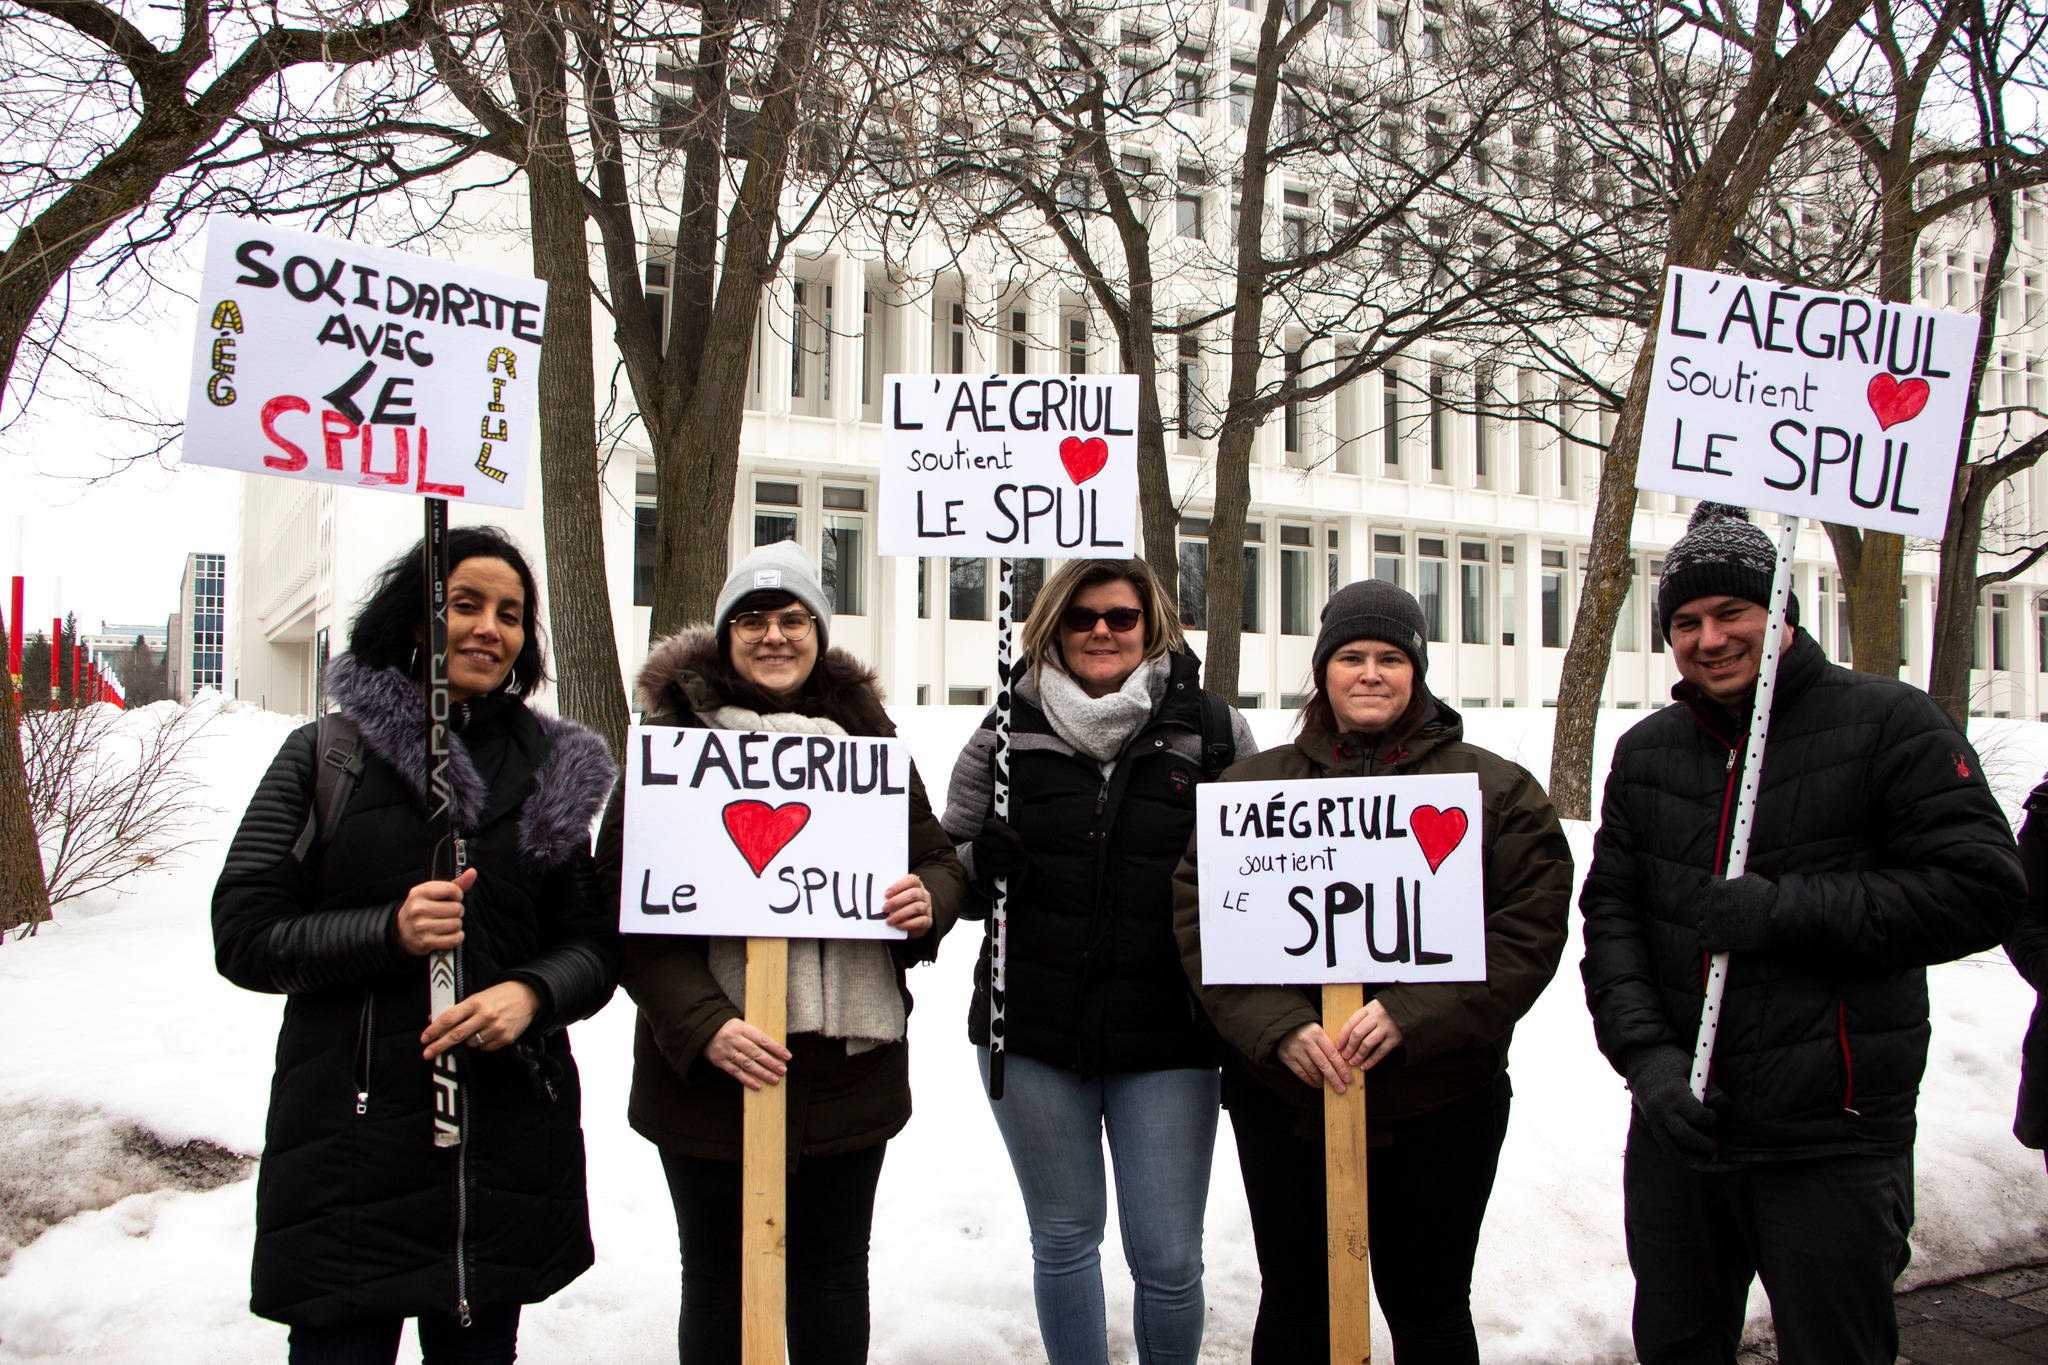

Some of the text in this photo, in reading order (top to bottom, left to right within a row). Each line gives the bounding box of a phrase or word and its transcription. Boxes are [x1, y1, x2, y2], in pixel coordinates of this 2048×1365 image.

[235, 240, 543, 345] SOLIDARITE
[317, 313, 433, 367] AVEC
[322, 360, 416, 426] LE
[474, 347, 517, 484] RIUL
[260, 395, 465, 497] SPUL
[907, 439, 1013, 472] soutient
[1672, 417, 1920, 516] LE SPUL
[917, 483, 1124, 548] LE SPUL
[428, 647, 449, 823] VAPOR
[1220, 791, 1408, 841] L'AÉGRIUL
[641, 866, 890, 921] Le SPUL
[1239, 846, 1337, 876] soutient
[1222, 876, 1453, 968] LE SPUL
